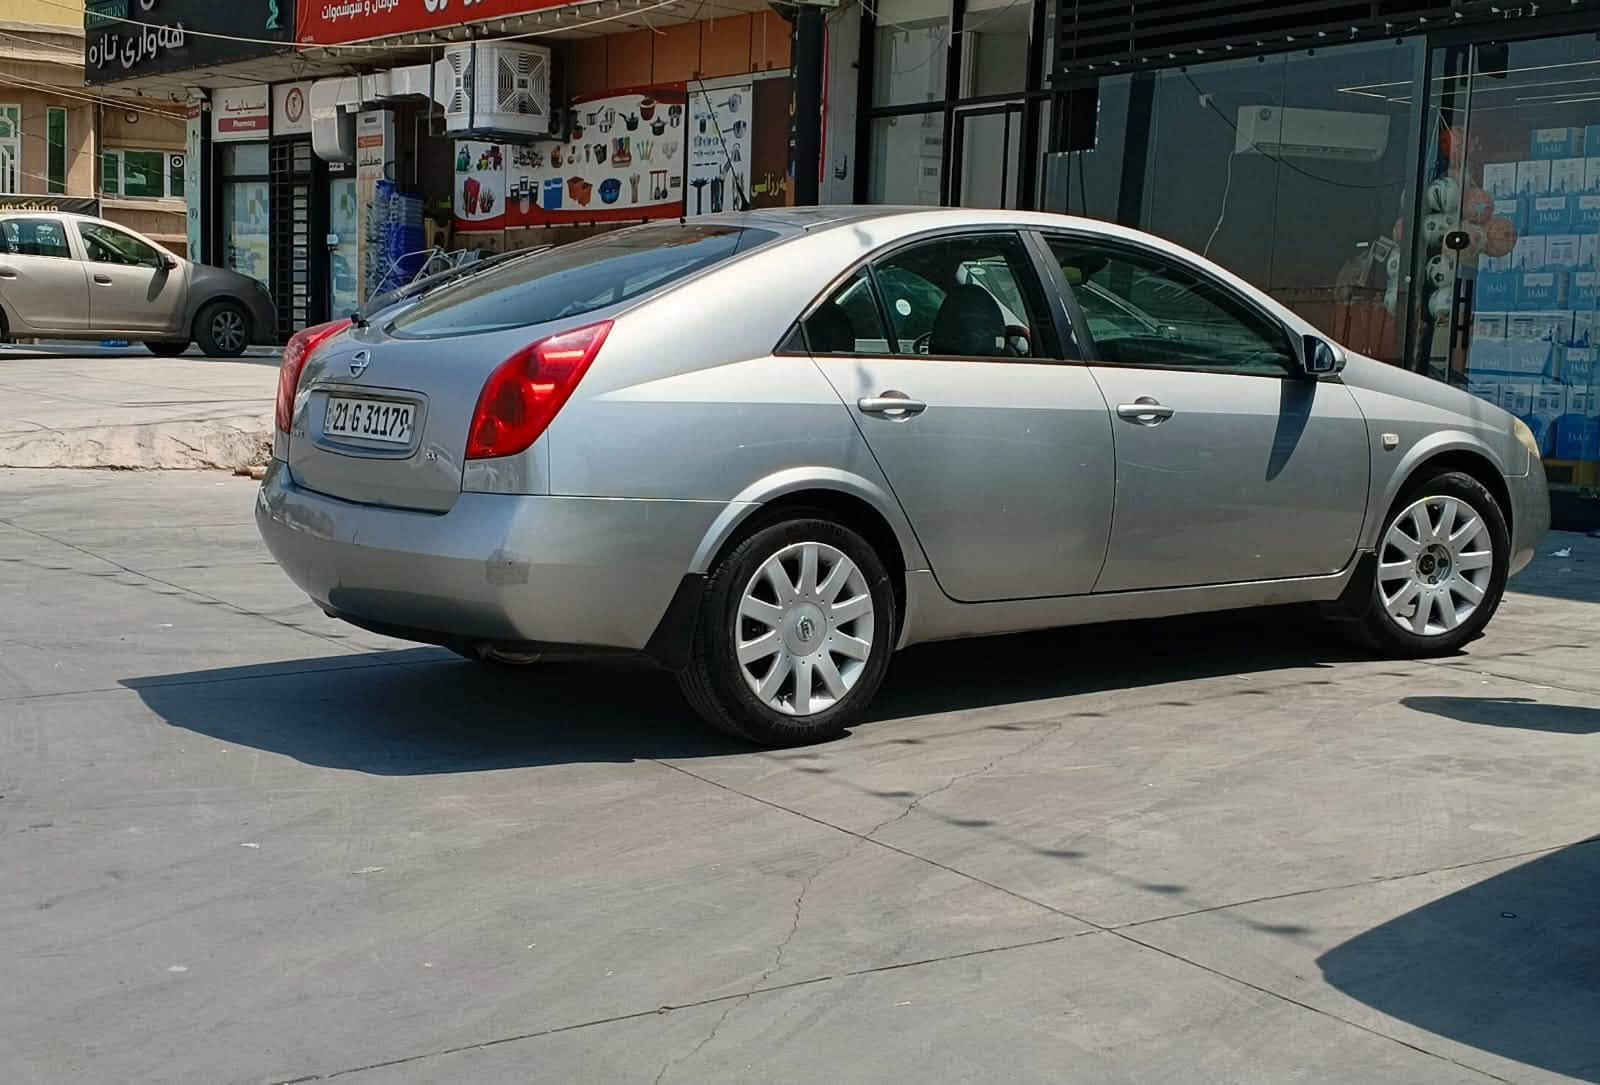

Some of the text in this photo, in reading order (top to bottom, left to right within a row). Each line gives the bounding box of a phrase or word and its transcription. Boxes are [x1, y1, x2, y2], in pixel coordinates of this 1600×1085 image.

[333, 402, 349, 431] 21
[351, 404, 362, 432] G
[363, 405, 409, 438] 31179
